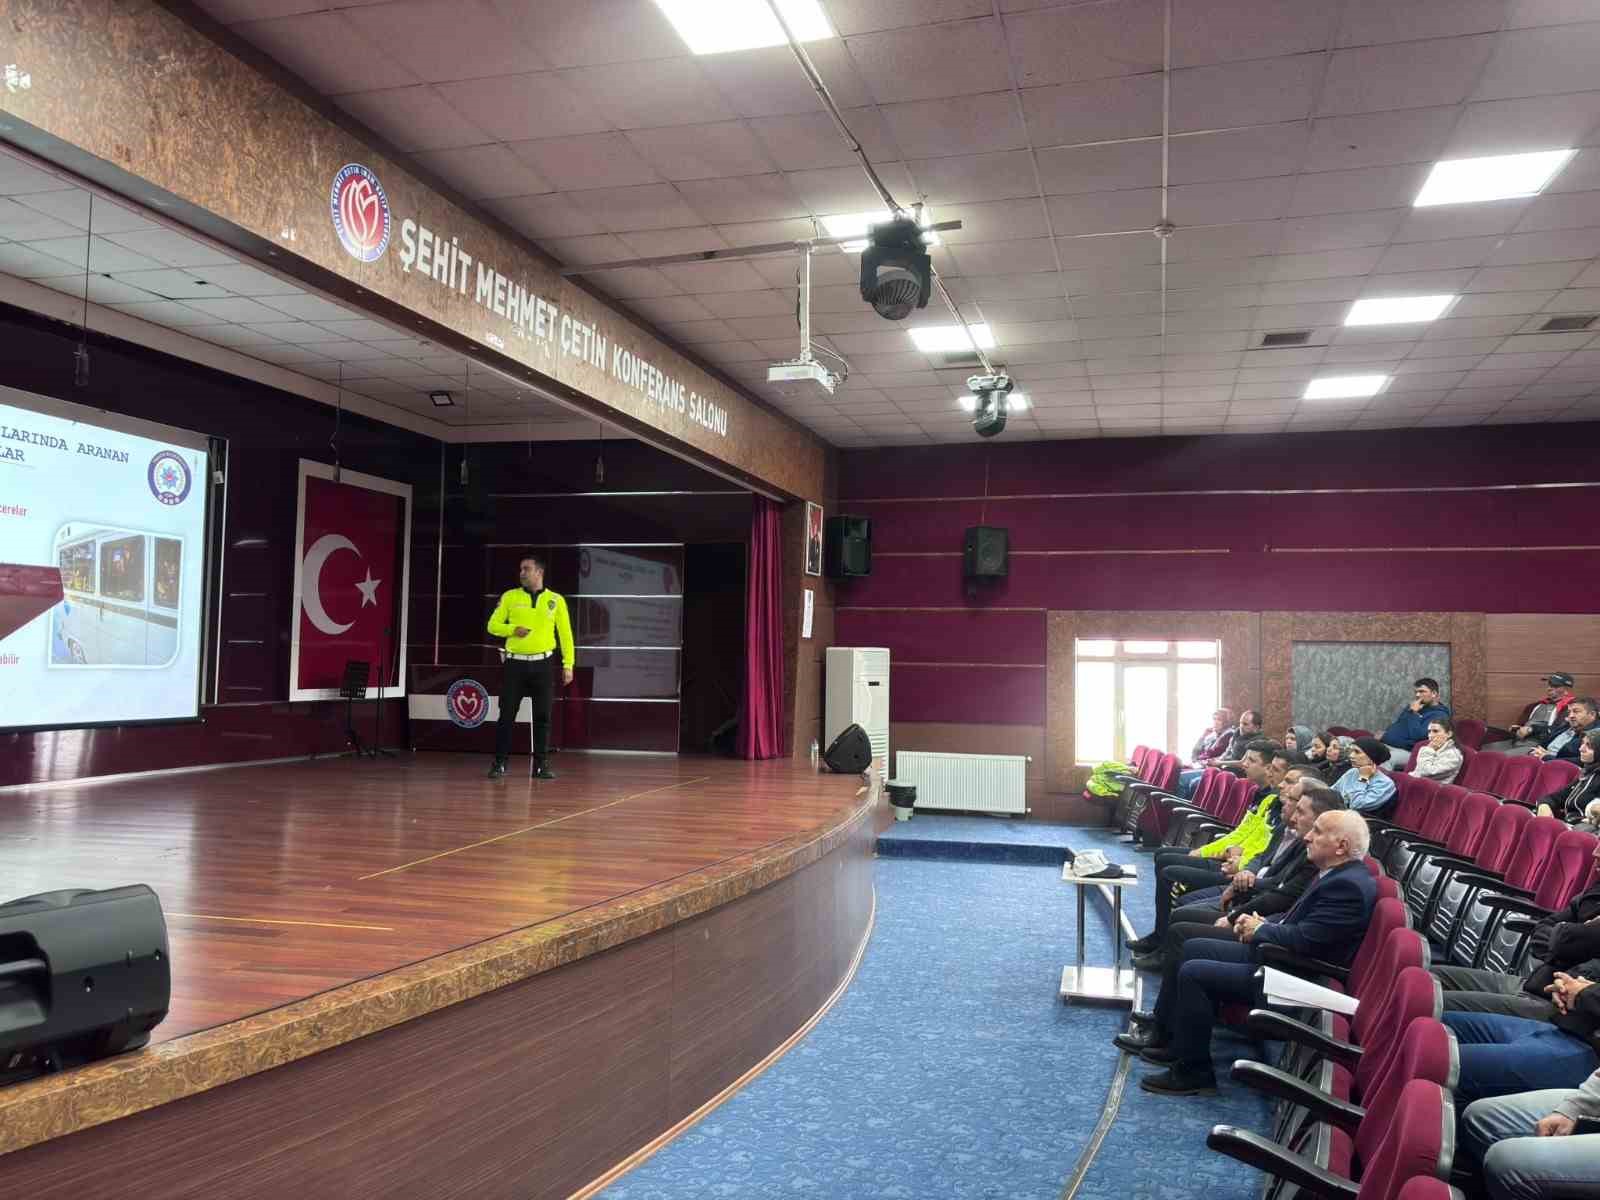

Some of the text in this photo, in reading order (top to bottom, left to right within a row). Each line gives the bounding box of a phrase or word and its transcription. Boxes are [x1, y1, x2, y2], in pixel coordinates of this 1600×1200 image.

[399, 218, 728, 437] ŞEHİT MEHMET ÇETİN KONFERANS SALONU
[0, 426, 129, 463] LARINDA ARANAN
